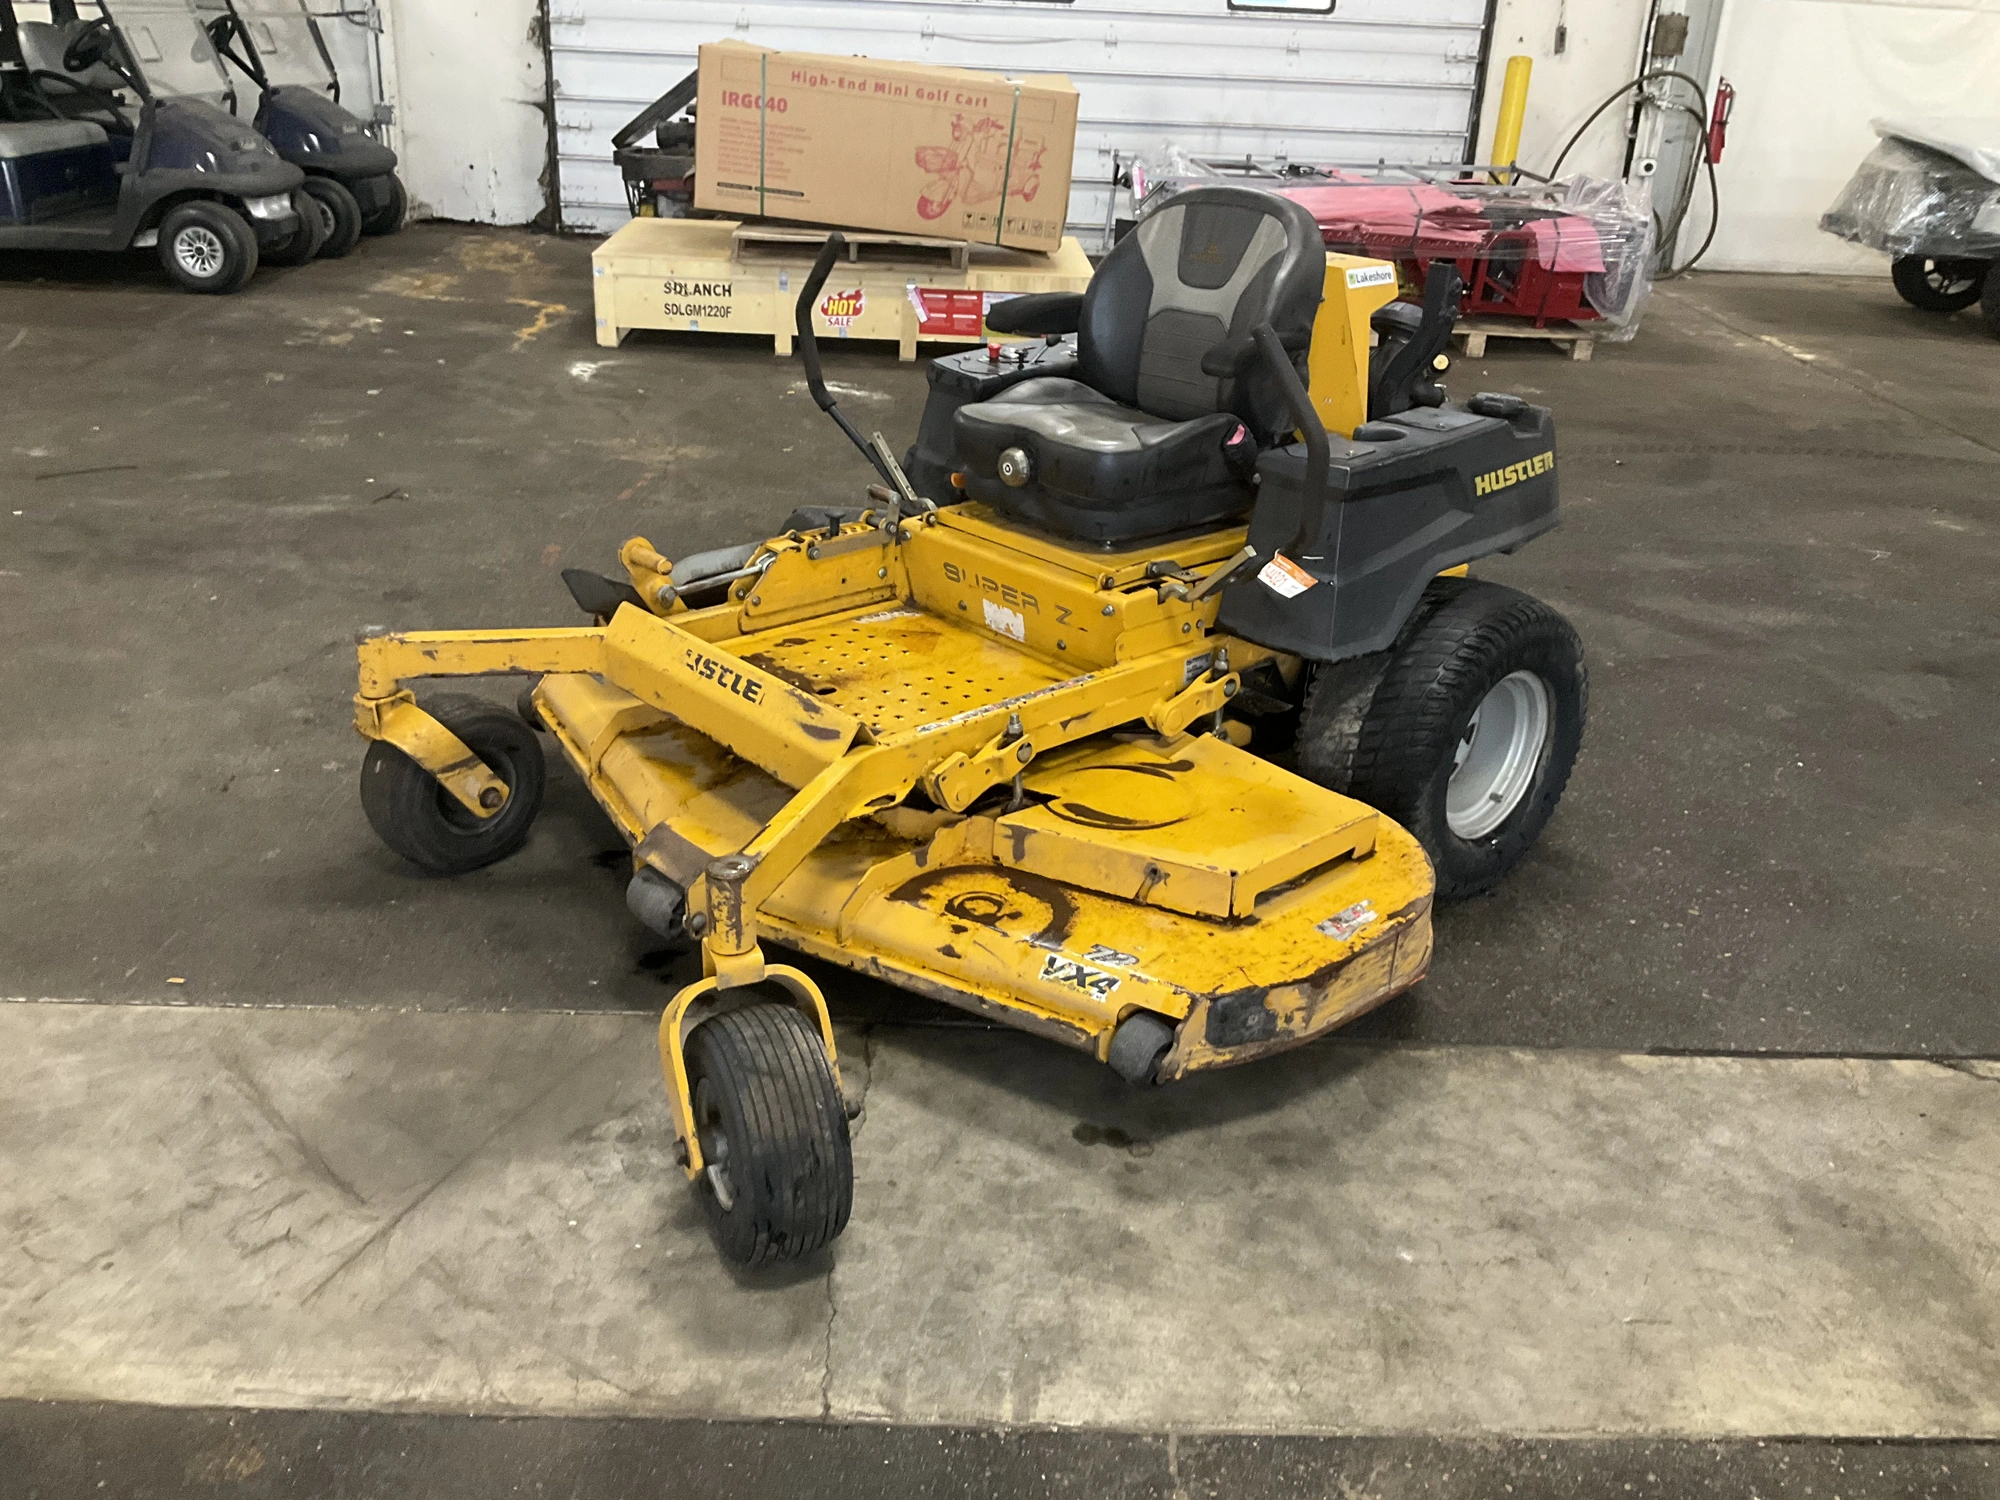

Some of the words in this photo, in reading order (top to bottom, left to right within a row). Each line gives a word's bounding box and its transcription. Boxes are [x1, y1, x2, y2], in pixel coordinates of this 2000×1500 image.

[791, 70, 867, 92] High-End
[874, 82, 909, 98] Mini
[915, 88, 950, 103] Golf
[955, 93, 989, 108] Cart
[1356, 271, 1392, 283] Lakeshore
[664, 303, 732, 318] SDLGM1220F
[827, 299, 857, 316] HOT
[828, 316, 852, 327] SALE
[1474, 450, 1554, 497] HUSTLER
[1055, 604, 1073, 626] Z
